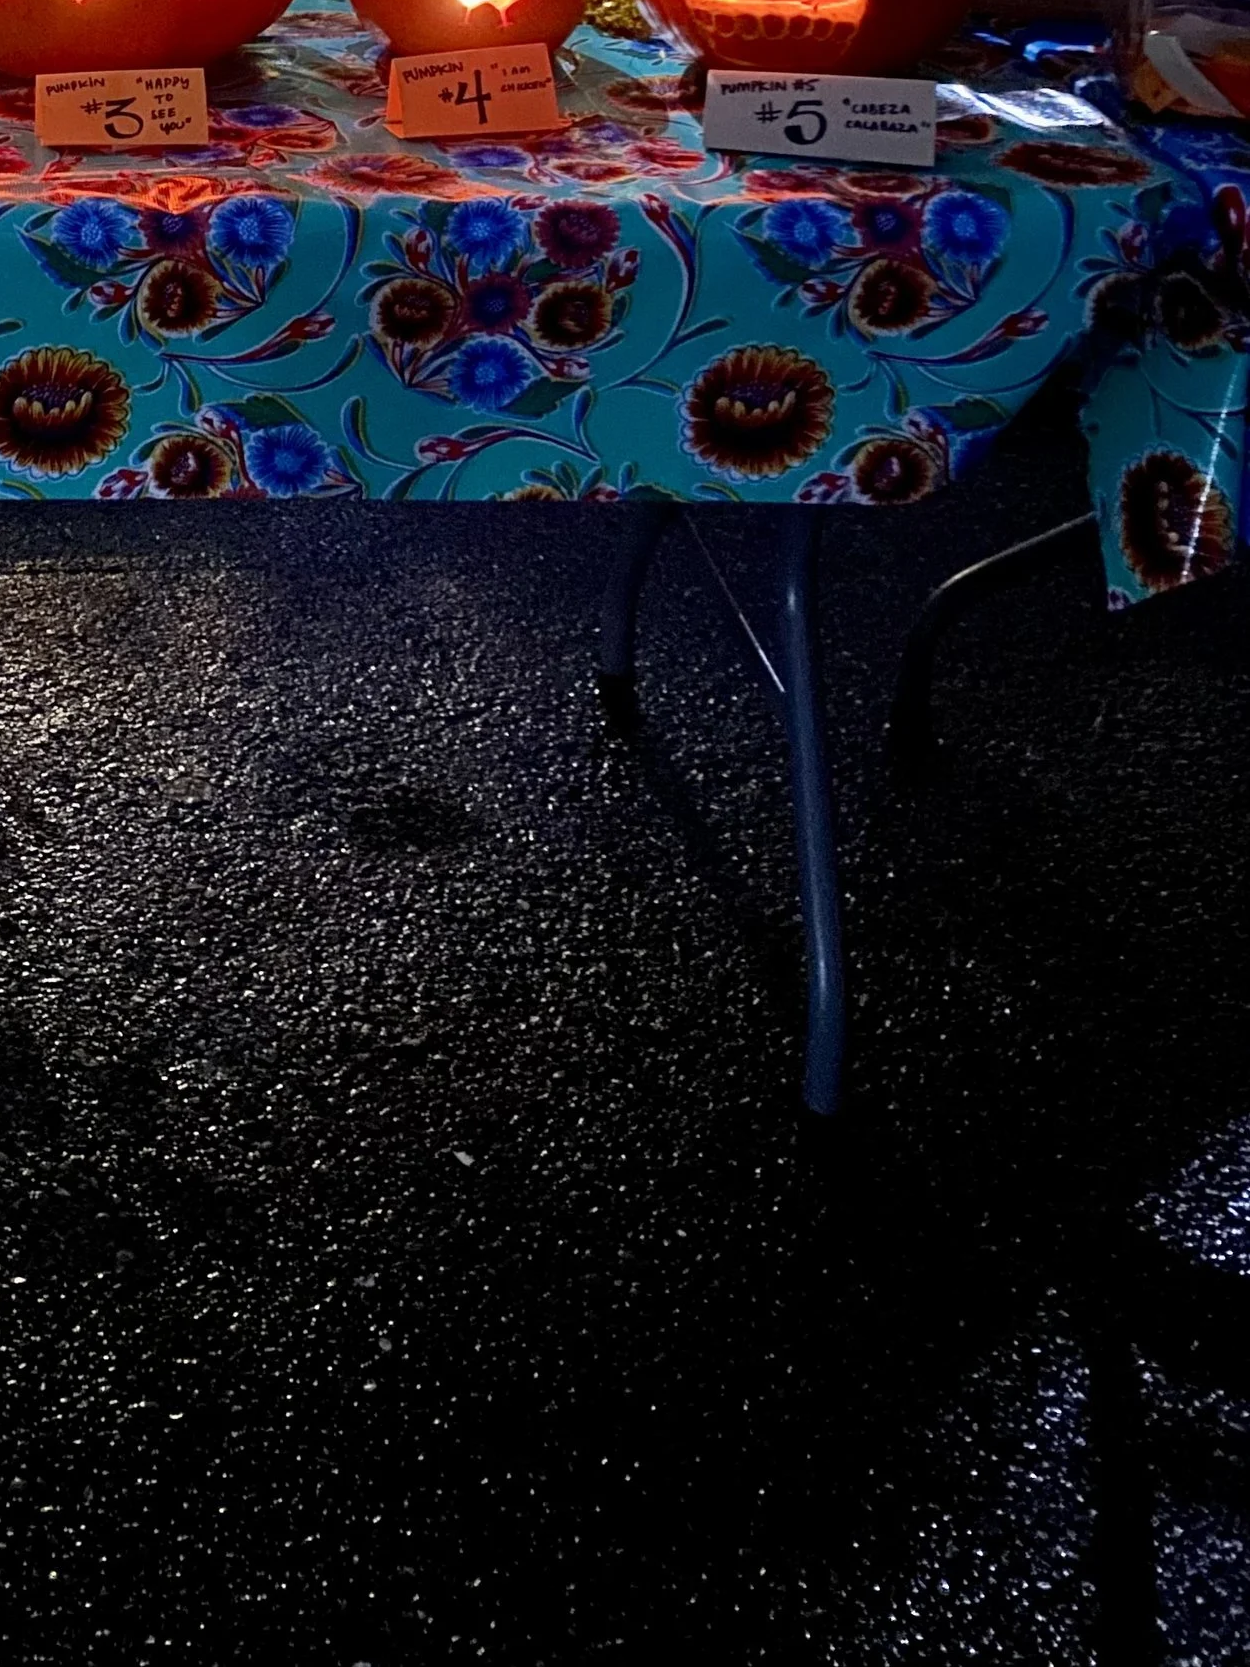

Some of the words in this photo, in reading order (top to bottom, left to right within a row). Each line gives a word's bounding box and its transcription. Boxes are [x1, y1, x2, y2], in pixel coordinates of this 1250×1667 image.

[402, 61, 464, 84] PUMPKIN
[511, 65, 531, 75] AM
[438, 69, 492, 125] #4
[720, 79, 788, 95] PUMPKIN
[792, 78, 820, 92] #5
[154, 93, 174, 105] TO
[79, 96, 144, 140] #3
[151, 107, 176, 120] SEE
[753, 99, 828, 145] #5
